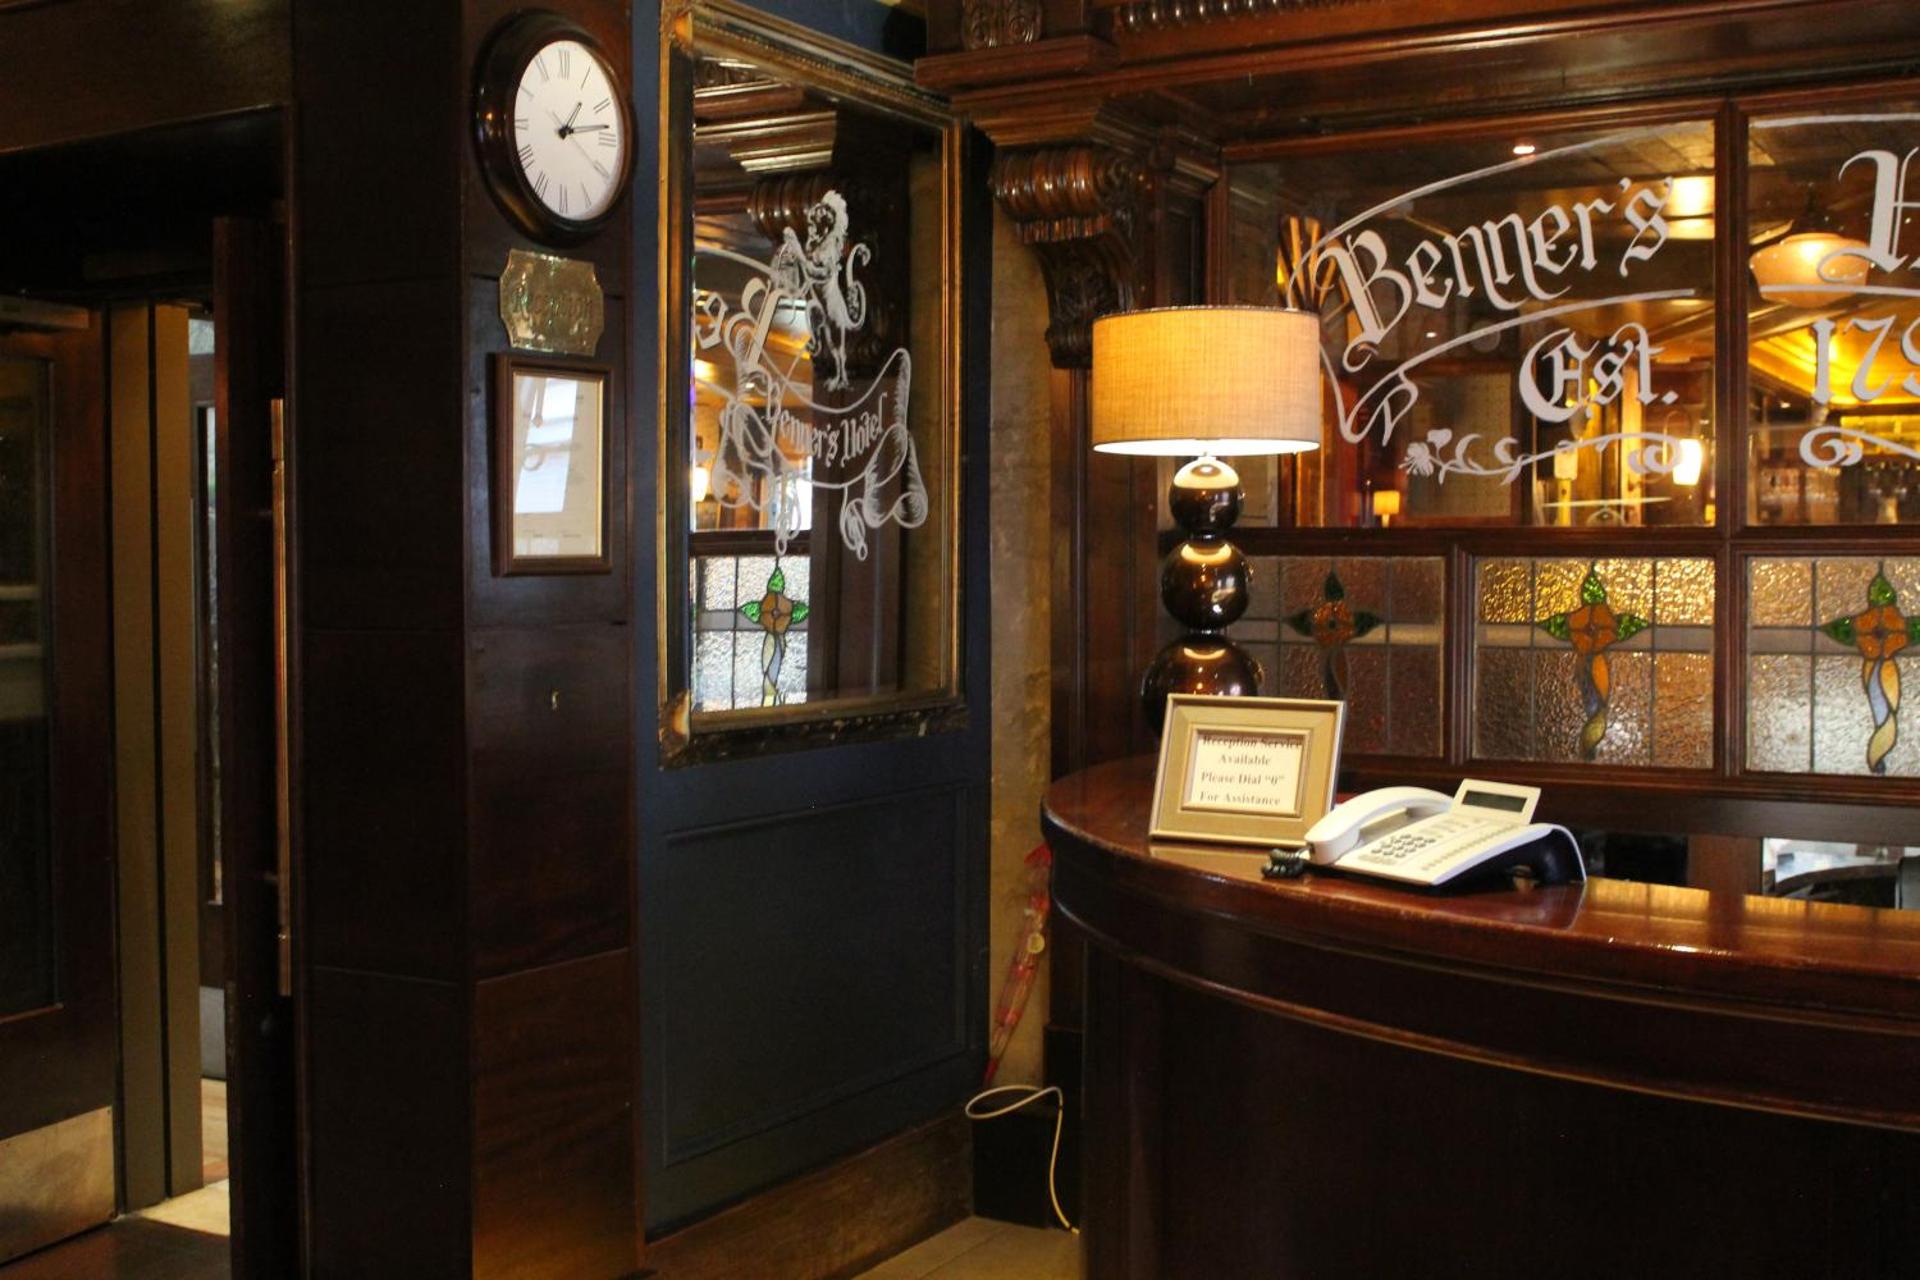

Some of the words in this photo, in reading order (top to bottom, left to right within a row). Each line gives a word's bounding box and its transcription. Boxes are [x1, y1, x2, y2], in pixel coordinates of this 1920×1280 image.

[1313, 176, 1675, 373] Benner's
[1518, 322, 1678, 422] Est.
[761, 382, 840, 468] Benner's
[841, 392, 888, 468] Hotel
[1200, 771, 1234, 784] Please
[1238, 773, 1262, 786] Dial
[1219, 754, 1271, 766] Available
[1199, 790, 1219, 803] For
[1226, 793, 1281, 806] Assistance
